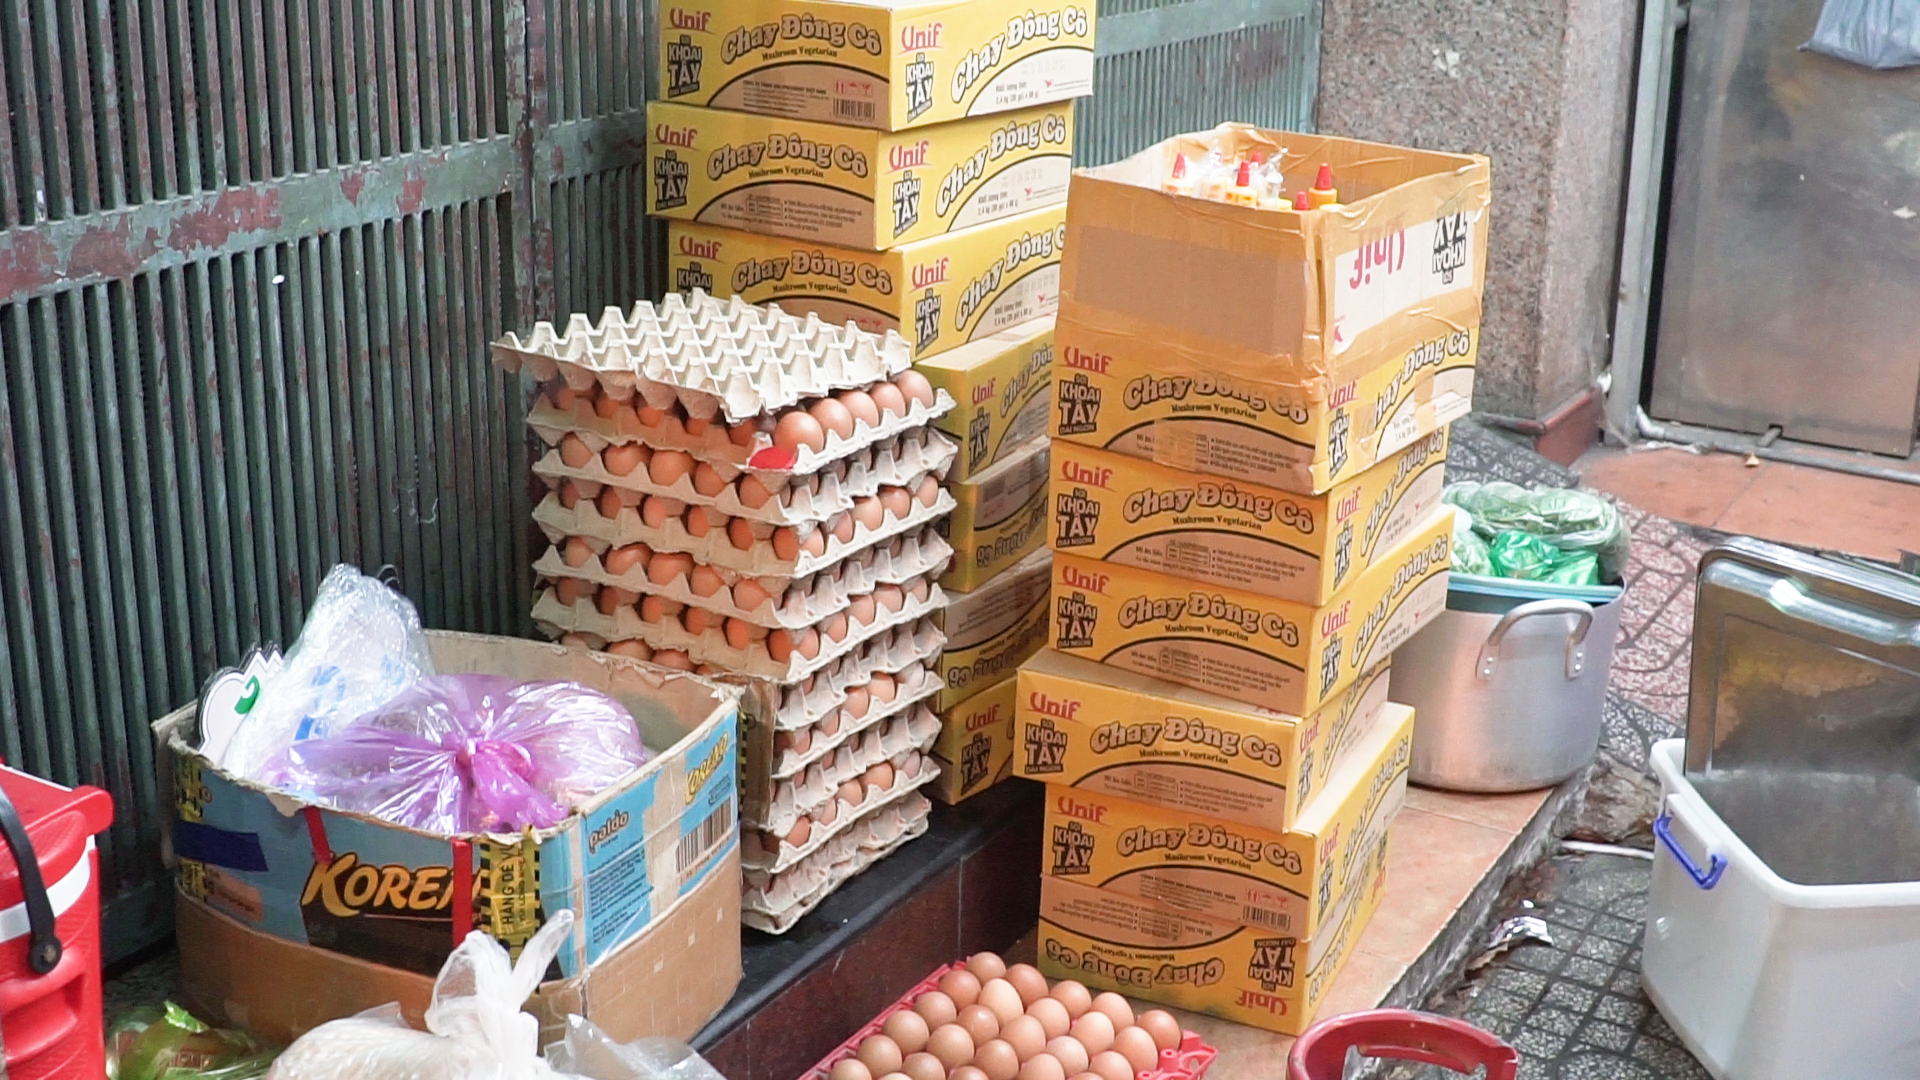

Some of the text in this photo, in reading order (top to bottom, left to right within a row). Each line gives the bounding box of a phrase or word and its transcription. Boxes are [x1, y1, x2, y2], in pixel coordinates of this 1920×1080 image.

[670, 8, 711, 31] Unif
[721, 22, 779, 64] Chay
[781, 12, 845, 46] Đông
[902, 23, 942, 50] Unif
[668, 43, 702, 61] KHOAI
[906, 62, 934, 85] KHOAI
[951, 32, 1005, 104] Chay
[655, 123, 698, 147] Unif
[655, 157, 688, 176] KHOAI
[707, 141, 765, 181] Chay
[768, 132, 832, 169] Đông
[889, 139, 929, 171] Unif
[893, 179, 920, 200] KHOAI
[936, 146, 988, 218] Chay
[679, 235, 722, 259] Unif
[677, 268, 712, 288] KHOAI
[732, 258, 789, 293] Chay
[791, 249, 856, 285] Đông
[912, 257, 949, 289] Unif
[955, 222, 1066, 331] Chay Đông C
[1064, 346, 1112, 374] Unif
[1059, 379, 1101, 402] KHOAI
[1123, 374, 1192, 411] Chay
[1214, 403, 1257, 420] Vegetarian
[1062, 460, 1113, 487] Unif
[1057, 493, 1100, 516] KHOAI
[1123, 487, 1194, 523] Chay
[1195, 482, 1273, 521] Đông
[1335, 486, 1361, 523] Unif
[1062, 565, 1110, 593] Unif
[1057, 597, 1097, 618] KHOAI
[1118, 594, 1185, 629] Chay
[1187, 592, 1259, 632] Đông
[1321, 600, 1350, 637] Unif
[965, 704, 1000, 732] Unif
[1030, 691, 1080, 720] Unif
[1026, 723, 1067, 746] KHOAI
[1090, 721, 1162, 754] Chay
[1164, 717, 1241, 756] Đông
[1058, 796, 1107, 823] Unif
[1053, 826, 1094, 847] KHOAI
[1116, 824, 1185, 857] Chay
[1187, 823, 1262, 862] Đông
[1156, 957, 1225, 987] Chay
[1248, 967, 1294, 988] KHOAI
[1235, 990, 1288, 1017] Unif
